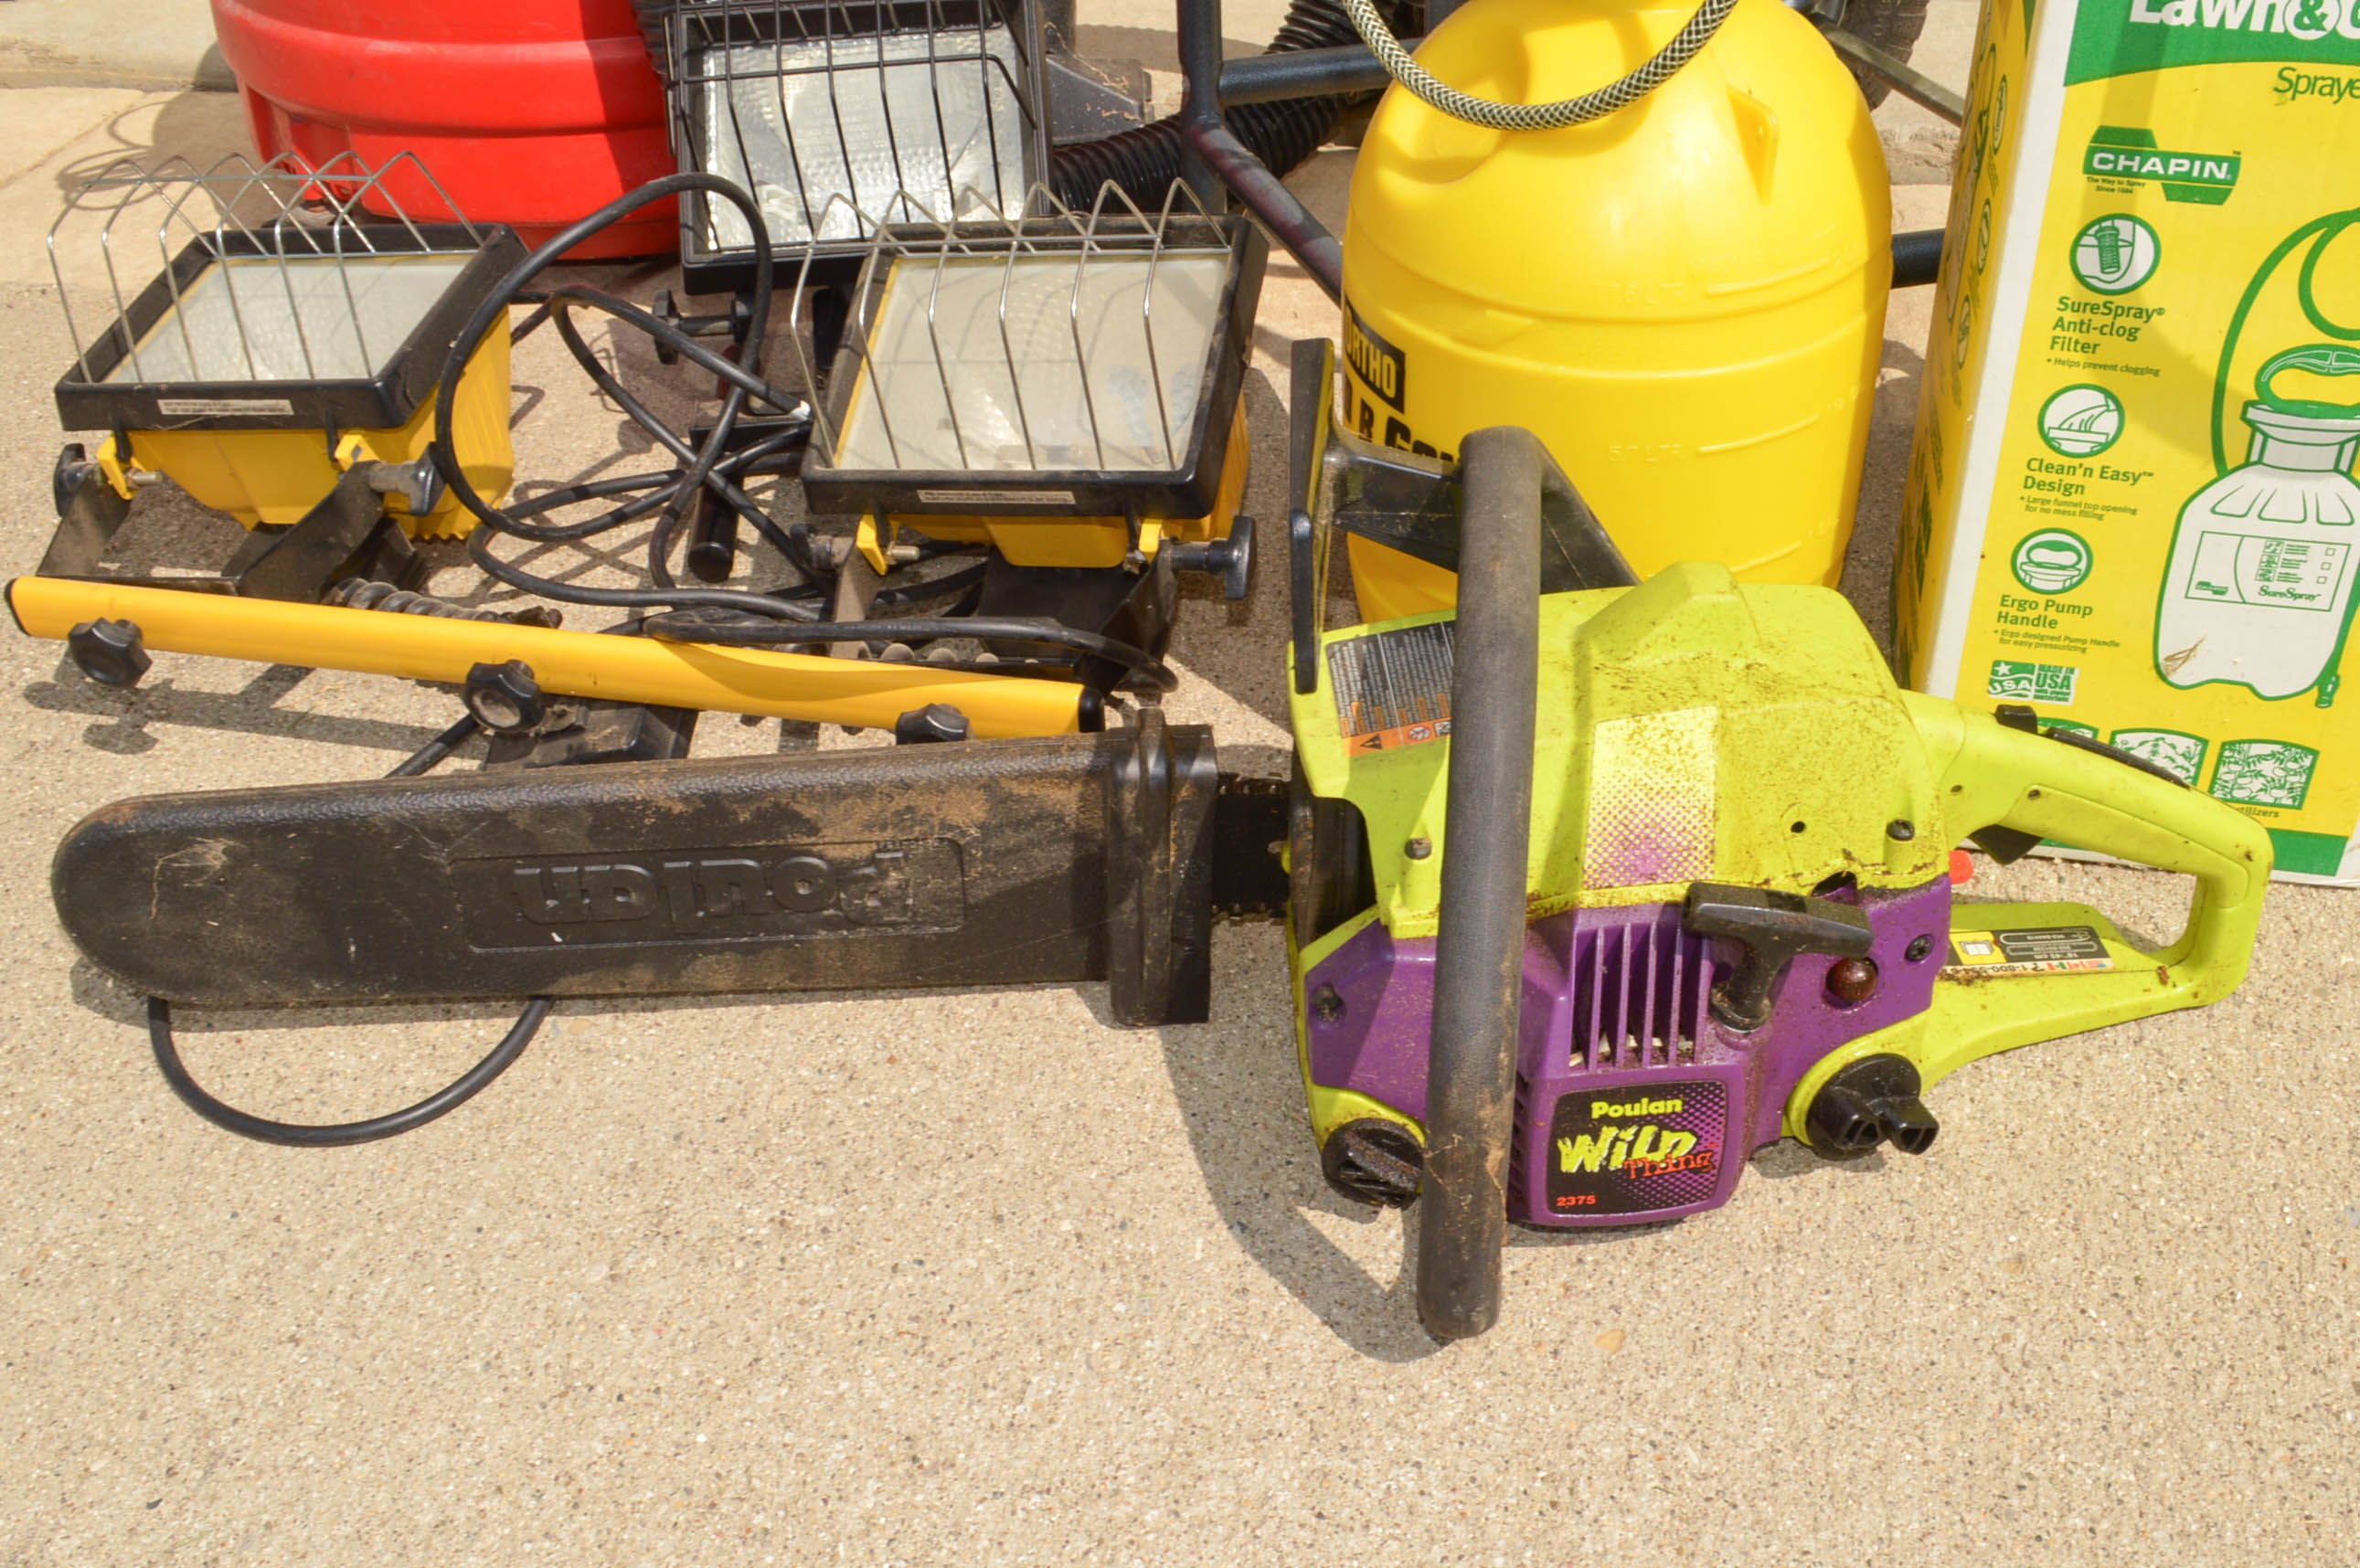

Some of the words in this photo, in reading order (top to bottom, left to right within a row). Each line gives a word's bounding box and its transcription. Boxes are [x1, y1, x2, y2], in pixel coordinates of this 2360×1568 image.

[2092, 152, 2230, 180] CHAPIN
[2052, 315, 2141, 342] Anti-clog
[1345, 301, 1398, 399] ORTHO
[2049, 335, 2100, 355] Filter
[2054, 357, 2080, 368] Helps
[2082, 360, 2119, 372] prevent
[2120, 364, 2162, 376] clogging
[2026, 457, 2094, 478] Clean'n
[2023, 475, 2085, 496] Design
[2025, 503, 2037, 513] for
[2084, 502, 2100, 511] top
[2100, 503, 2137, 515] opening
[2000, 594, 2039, 612] Ergo
[2044, 599, 2093, 619] Pump
[1996, 610, 2058, 629] Handle
[2035, 673, 2072, 690] USA
[1590, 1097, 1684, 1118] Poulan
[1623, 1151, 1715, 1180] Thing
[1557, 1194, 1597, 1207] 2375
